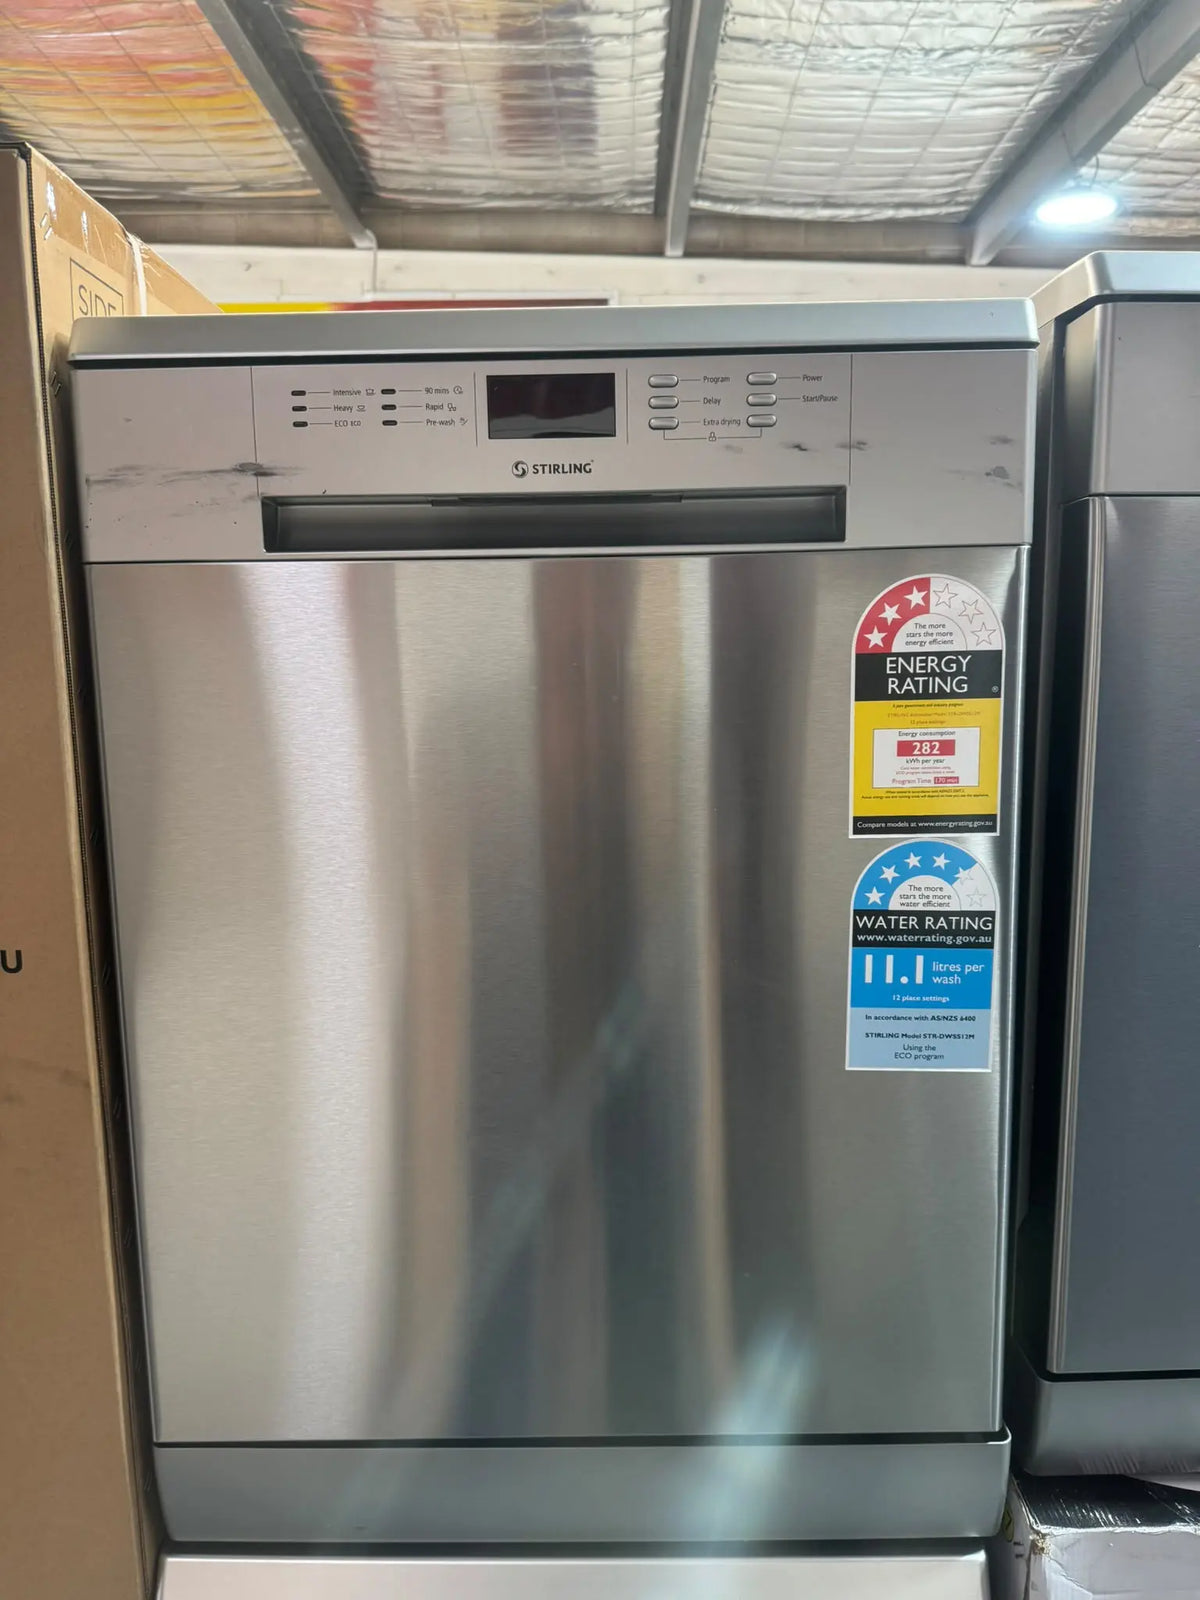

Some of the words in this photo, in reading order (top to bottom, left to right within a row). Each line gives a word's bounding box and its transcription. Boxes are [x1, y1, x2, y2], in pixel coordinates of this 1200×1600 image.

[703, 375, 730, 384] Program
[802, 374, 823, 382] Power
[333, 388, 362, 397] Intensive
[424, 387, 434, 395] 90
[434, 387, 450, 395] mins
[703, 397, 721, 406] Delay
[802, 394, 839, 402] Start/Pause
[333, 404, 354, 413] Heavy
[425, 403, 444, 412] Rapid
[334, 420, 348, 428] ECO
[426, 418, 455, 427] Pre-wash
[703, 418, 719, 426] Extra
[720, 418, 741, 427] drying
[532, 463, 592, 474] STIRLING
[886, 655, 972, 674] ENERGY
[888, 676, 968, 694] RATING
[898, 730, 918, 738] Energy
[919, 730, 956, 738] consumption
[912, 741, 940, 755] 282
[857, 821, 885, 829] Compare
[918, 820, 993, 829] www.energyrating.gov.au
[855, 915, 918, 929] WATER
[924, 916, 993, 930] RATING
[856, 933, 992, 945] www.waterrating.gov.au
[864, 954, 924, 984] 11.1
[932, 961, 961, 972] litres
[964, 963, 984, 975] per
[931, 974, 961, 985] wash
[901, 994, 921, 1002] place
[922, 995, 950, 1003] settings
[902, 1043, 923, 1052] Using
[914, 1053, 944, 1061] program
